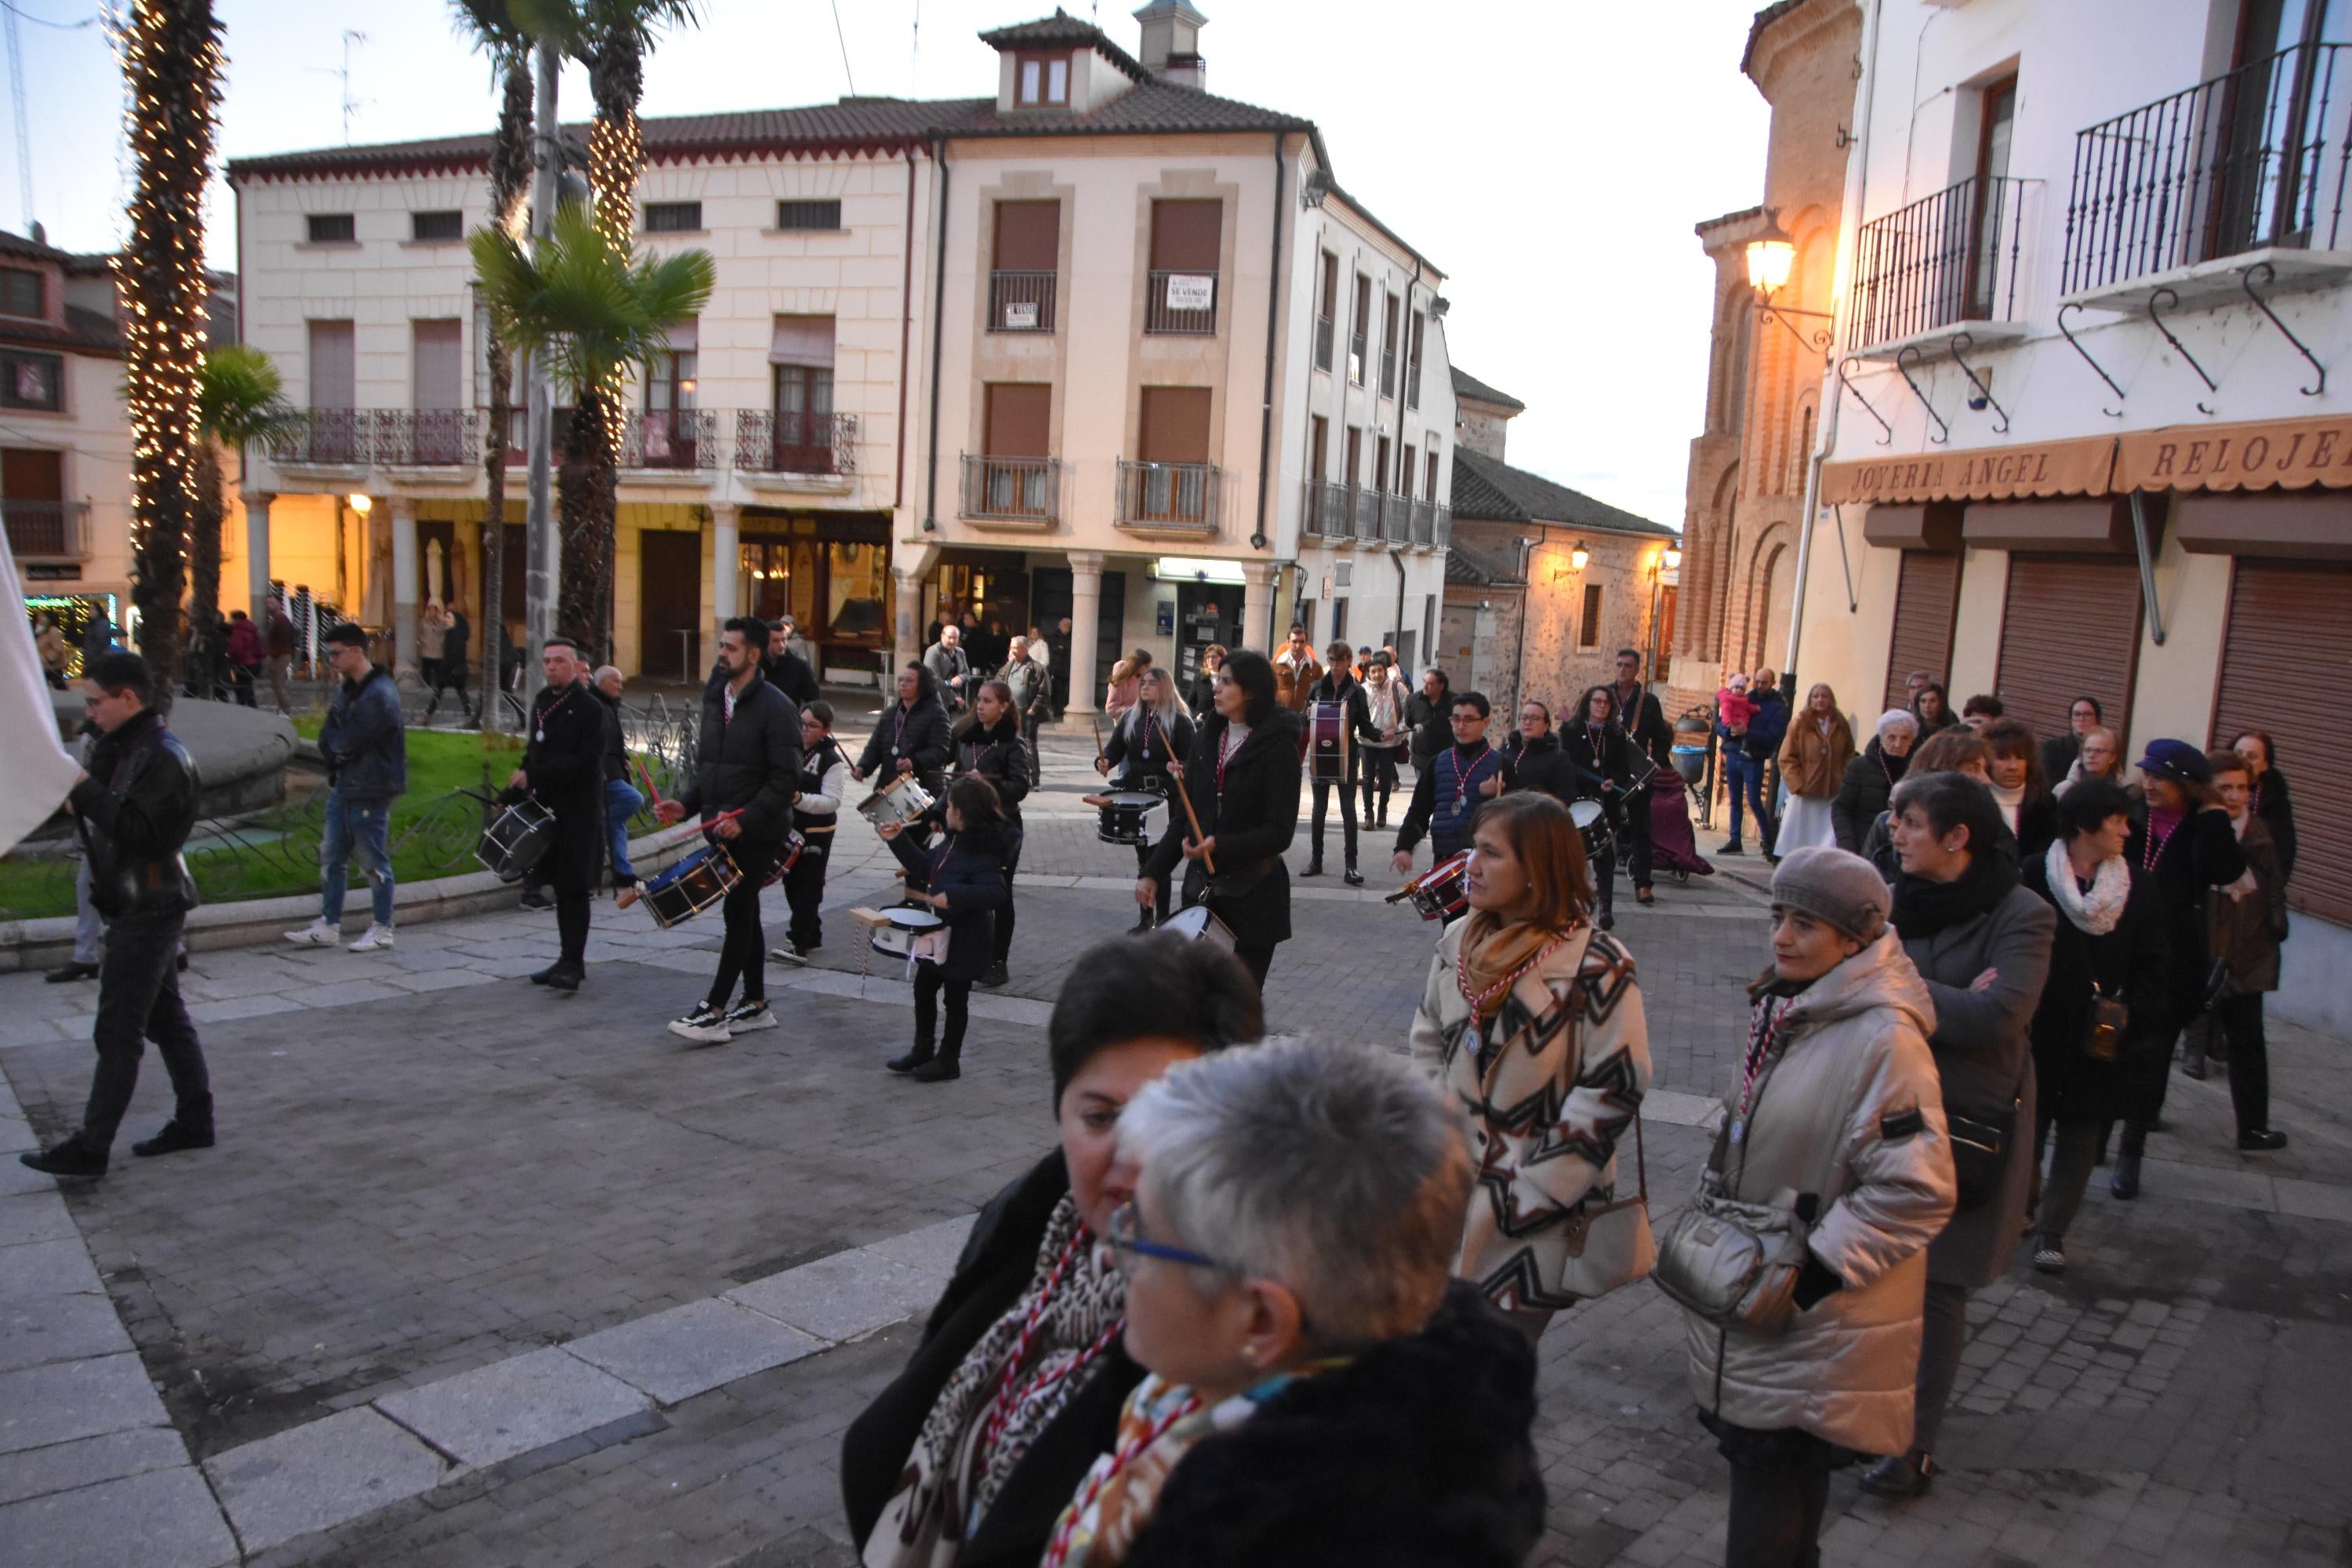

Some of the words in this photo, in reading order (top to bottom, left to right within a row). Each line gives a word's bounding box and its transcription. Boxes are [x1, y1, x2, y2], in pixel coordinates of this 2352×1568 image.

[1182, 288, 1207, 296] VENDE
[1851, 461, 1944, 491] JOYERIA
[1959, 453, 2049, 485] ANGEL
[804, 753, 821, 775] A
